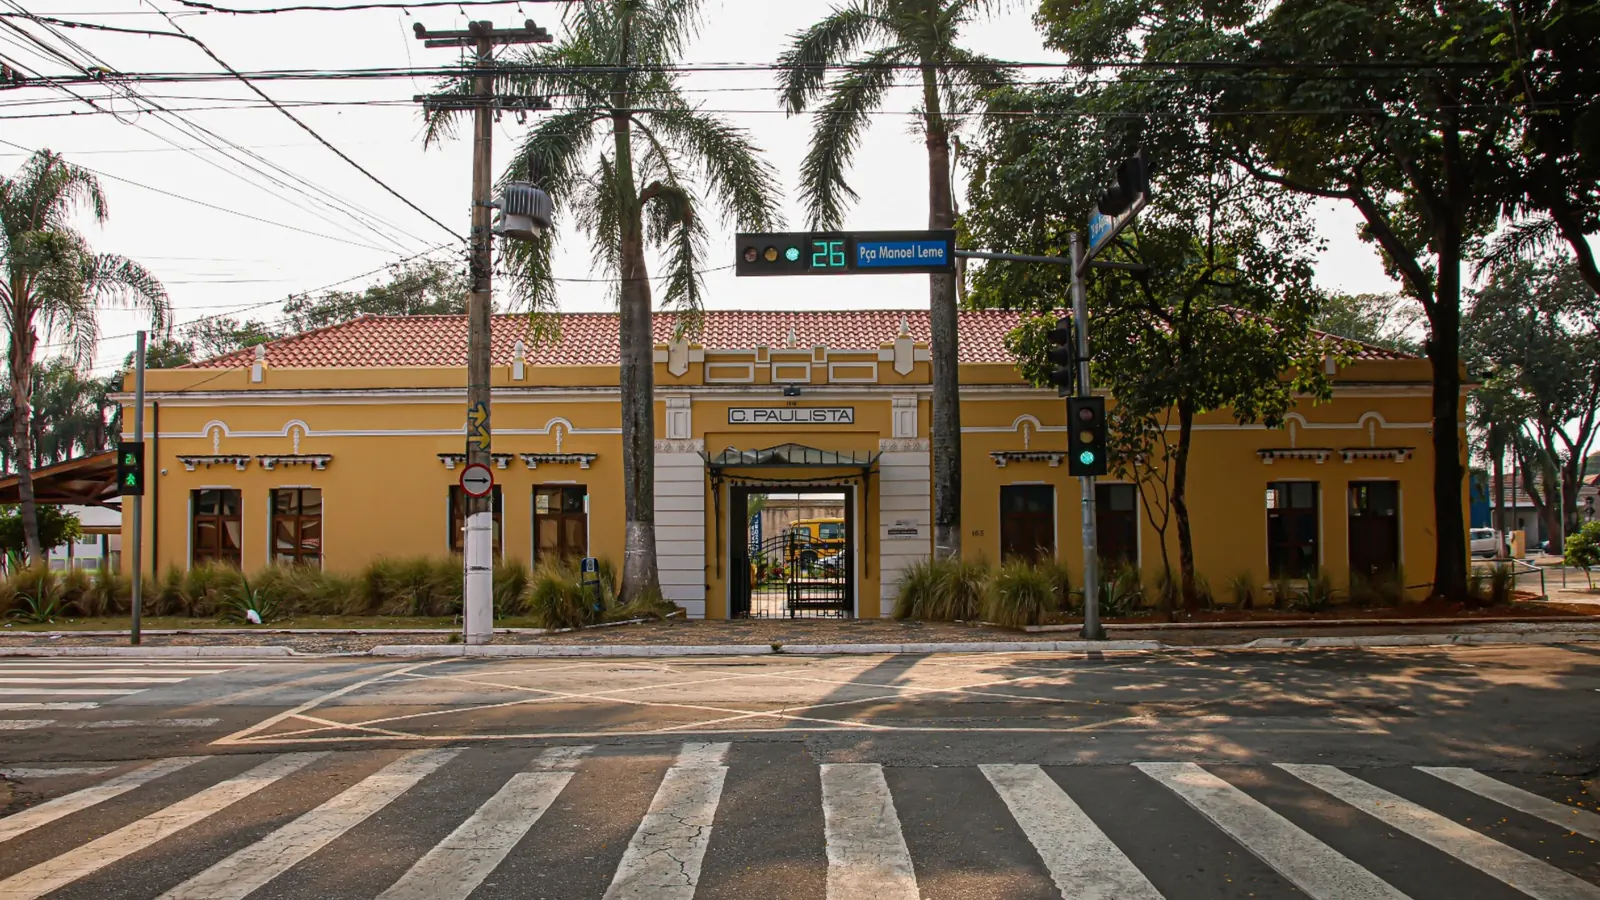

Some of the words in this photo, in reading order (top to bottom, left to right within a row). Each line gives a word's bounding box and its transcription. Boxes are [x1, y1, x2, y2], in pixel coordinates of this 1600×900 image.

[812, 241, 845, 267] 26
[860, 246, 877, 263] Pça
[879, 245, 915, 259] Manoel
[918, 245, 944, 258] Leme
[731, 410, 749, 422] C.
[753, 410, 851, 422] PAULISTA
